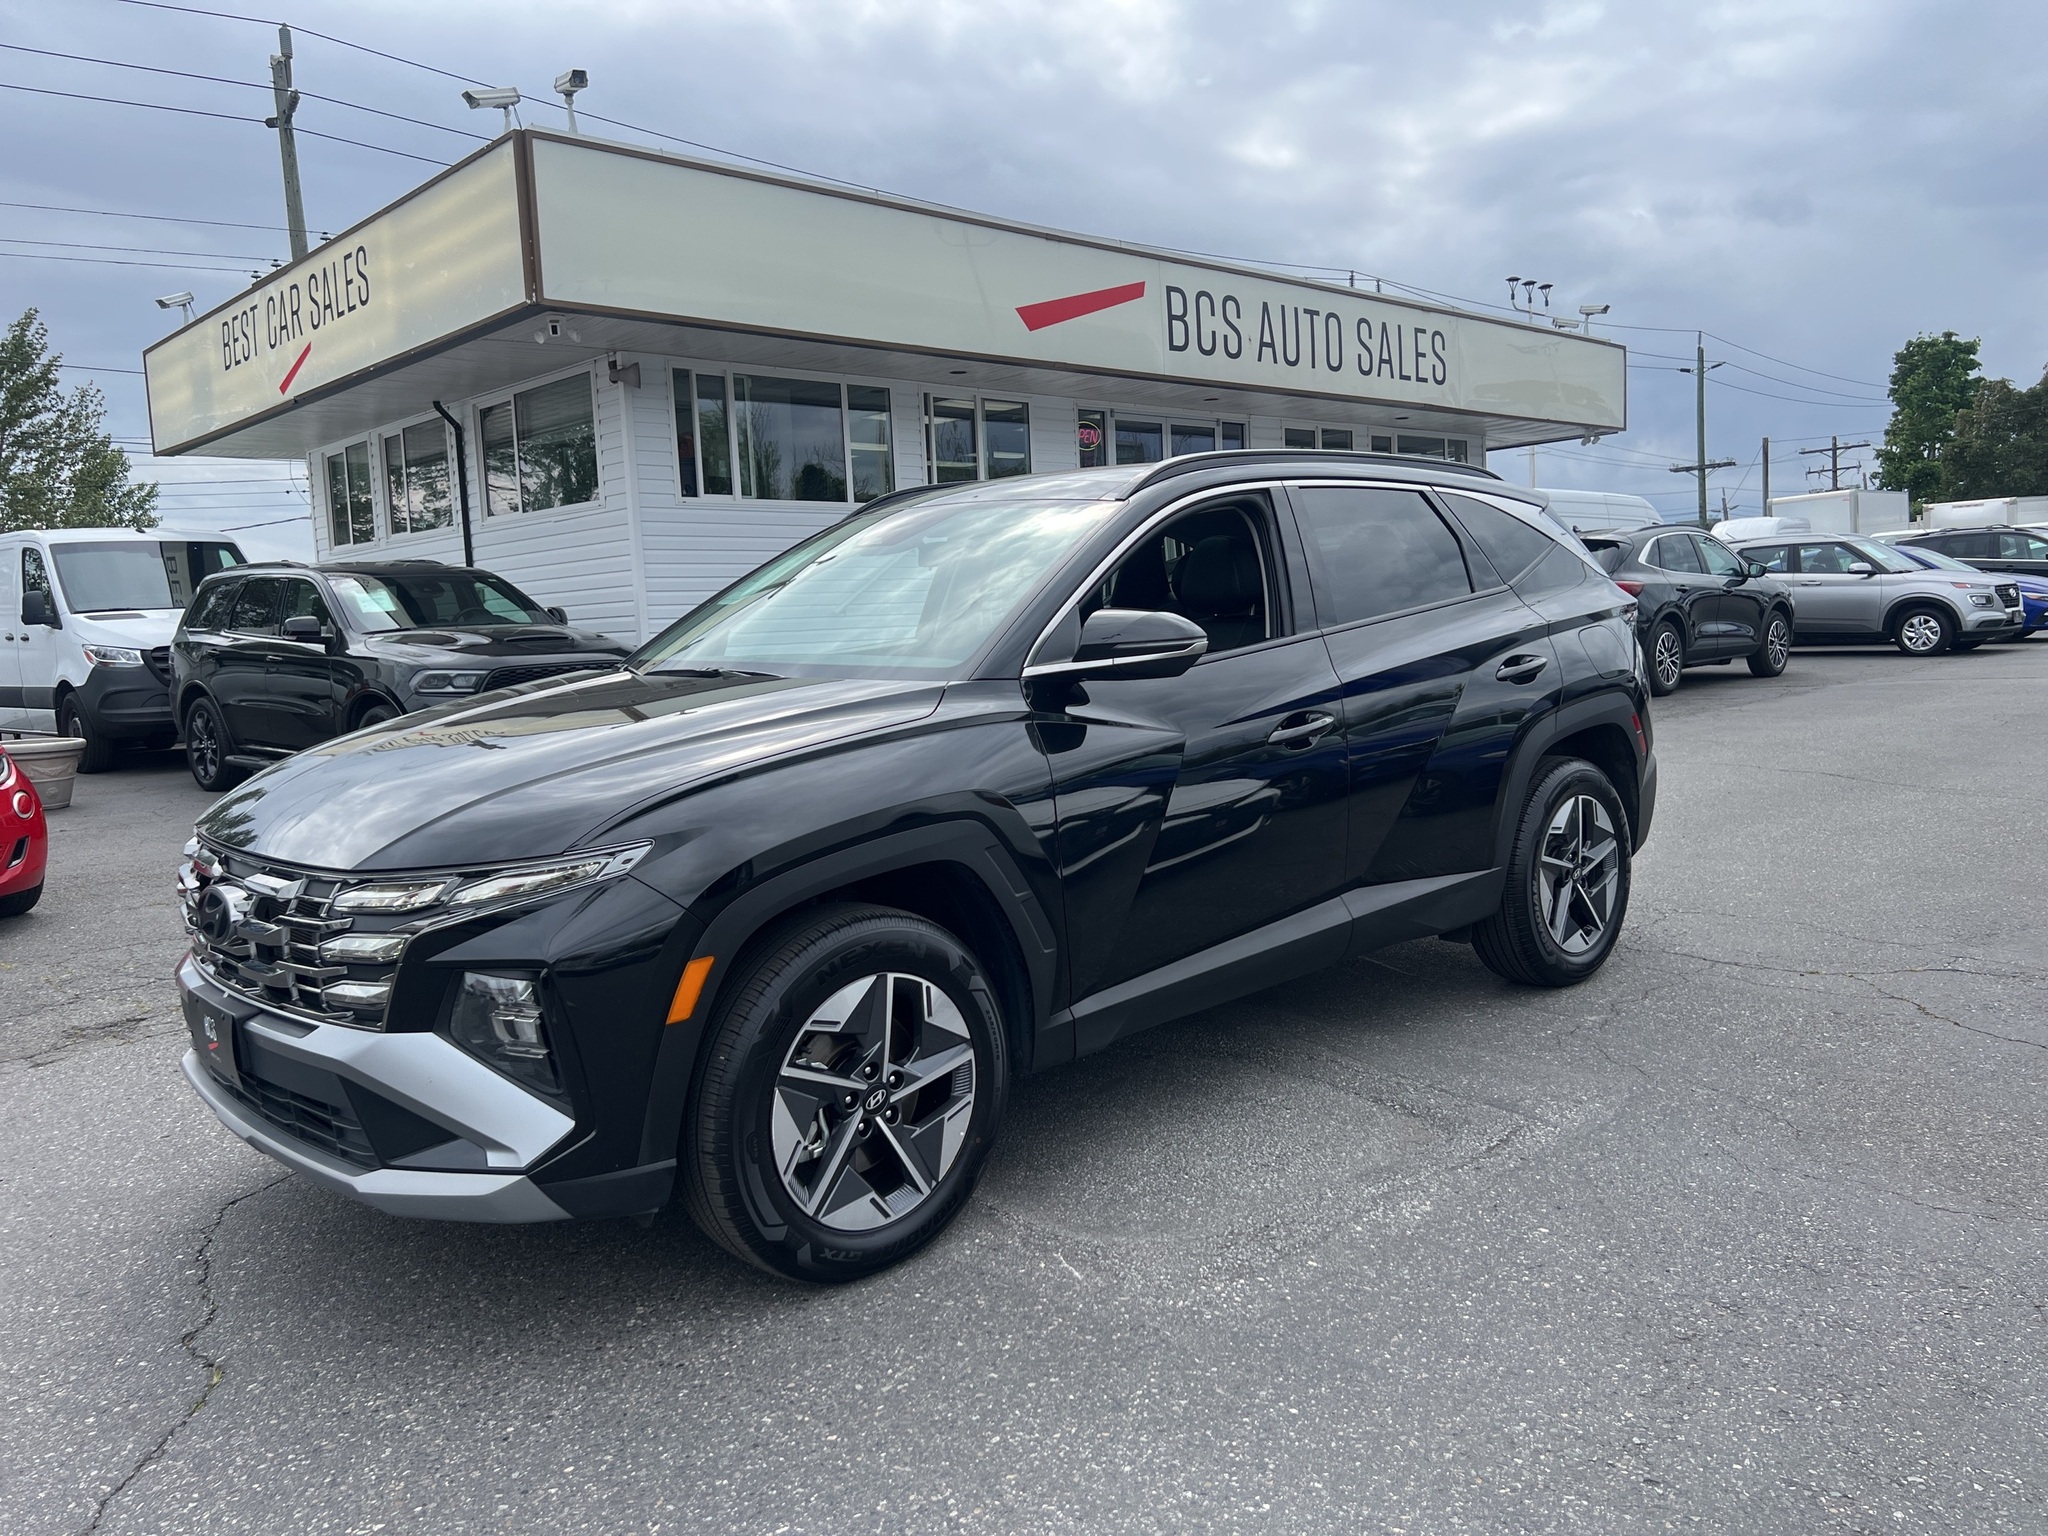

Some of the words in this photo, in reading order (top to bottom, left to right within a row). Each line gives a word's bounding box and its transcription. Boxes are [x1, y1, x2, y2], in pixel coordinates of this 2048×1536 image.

[222, 304, 258, 371] BEST
[267, 283, 304, 350] CAR
[308, 246, 370, 330] SALES
[1165, 285, 1243, 360] BCS
[1257, 301, 1344, 373] AUTO
[1356, 317, 1447, 386] SALES
[1078, 428, 1099, 444] PEN
[815, 940, 928, 986] NEXEN
